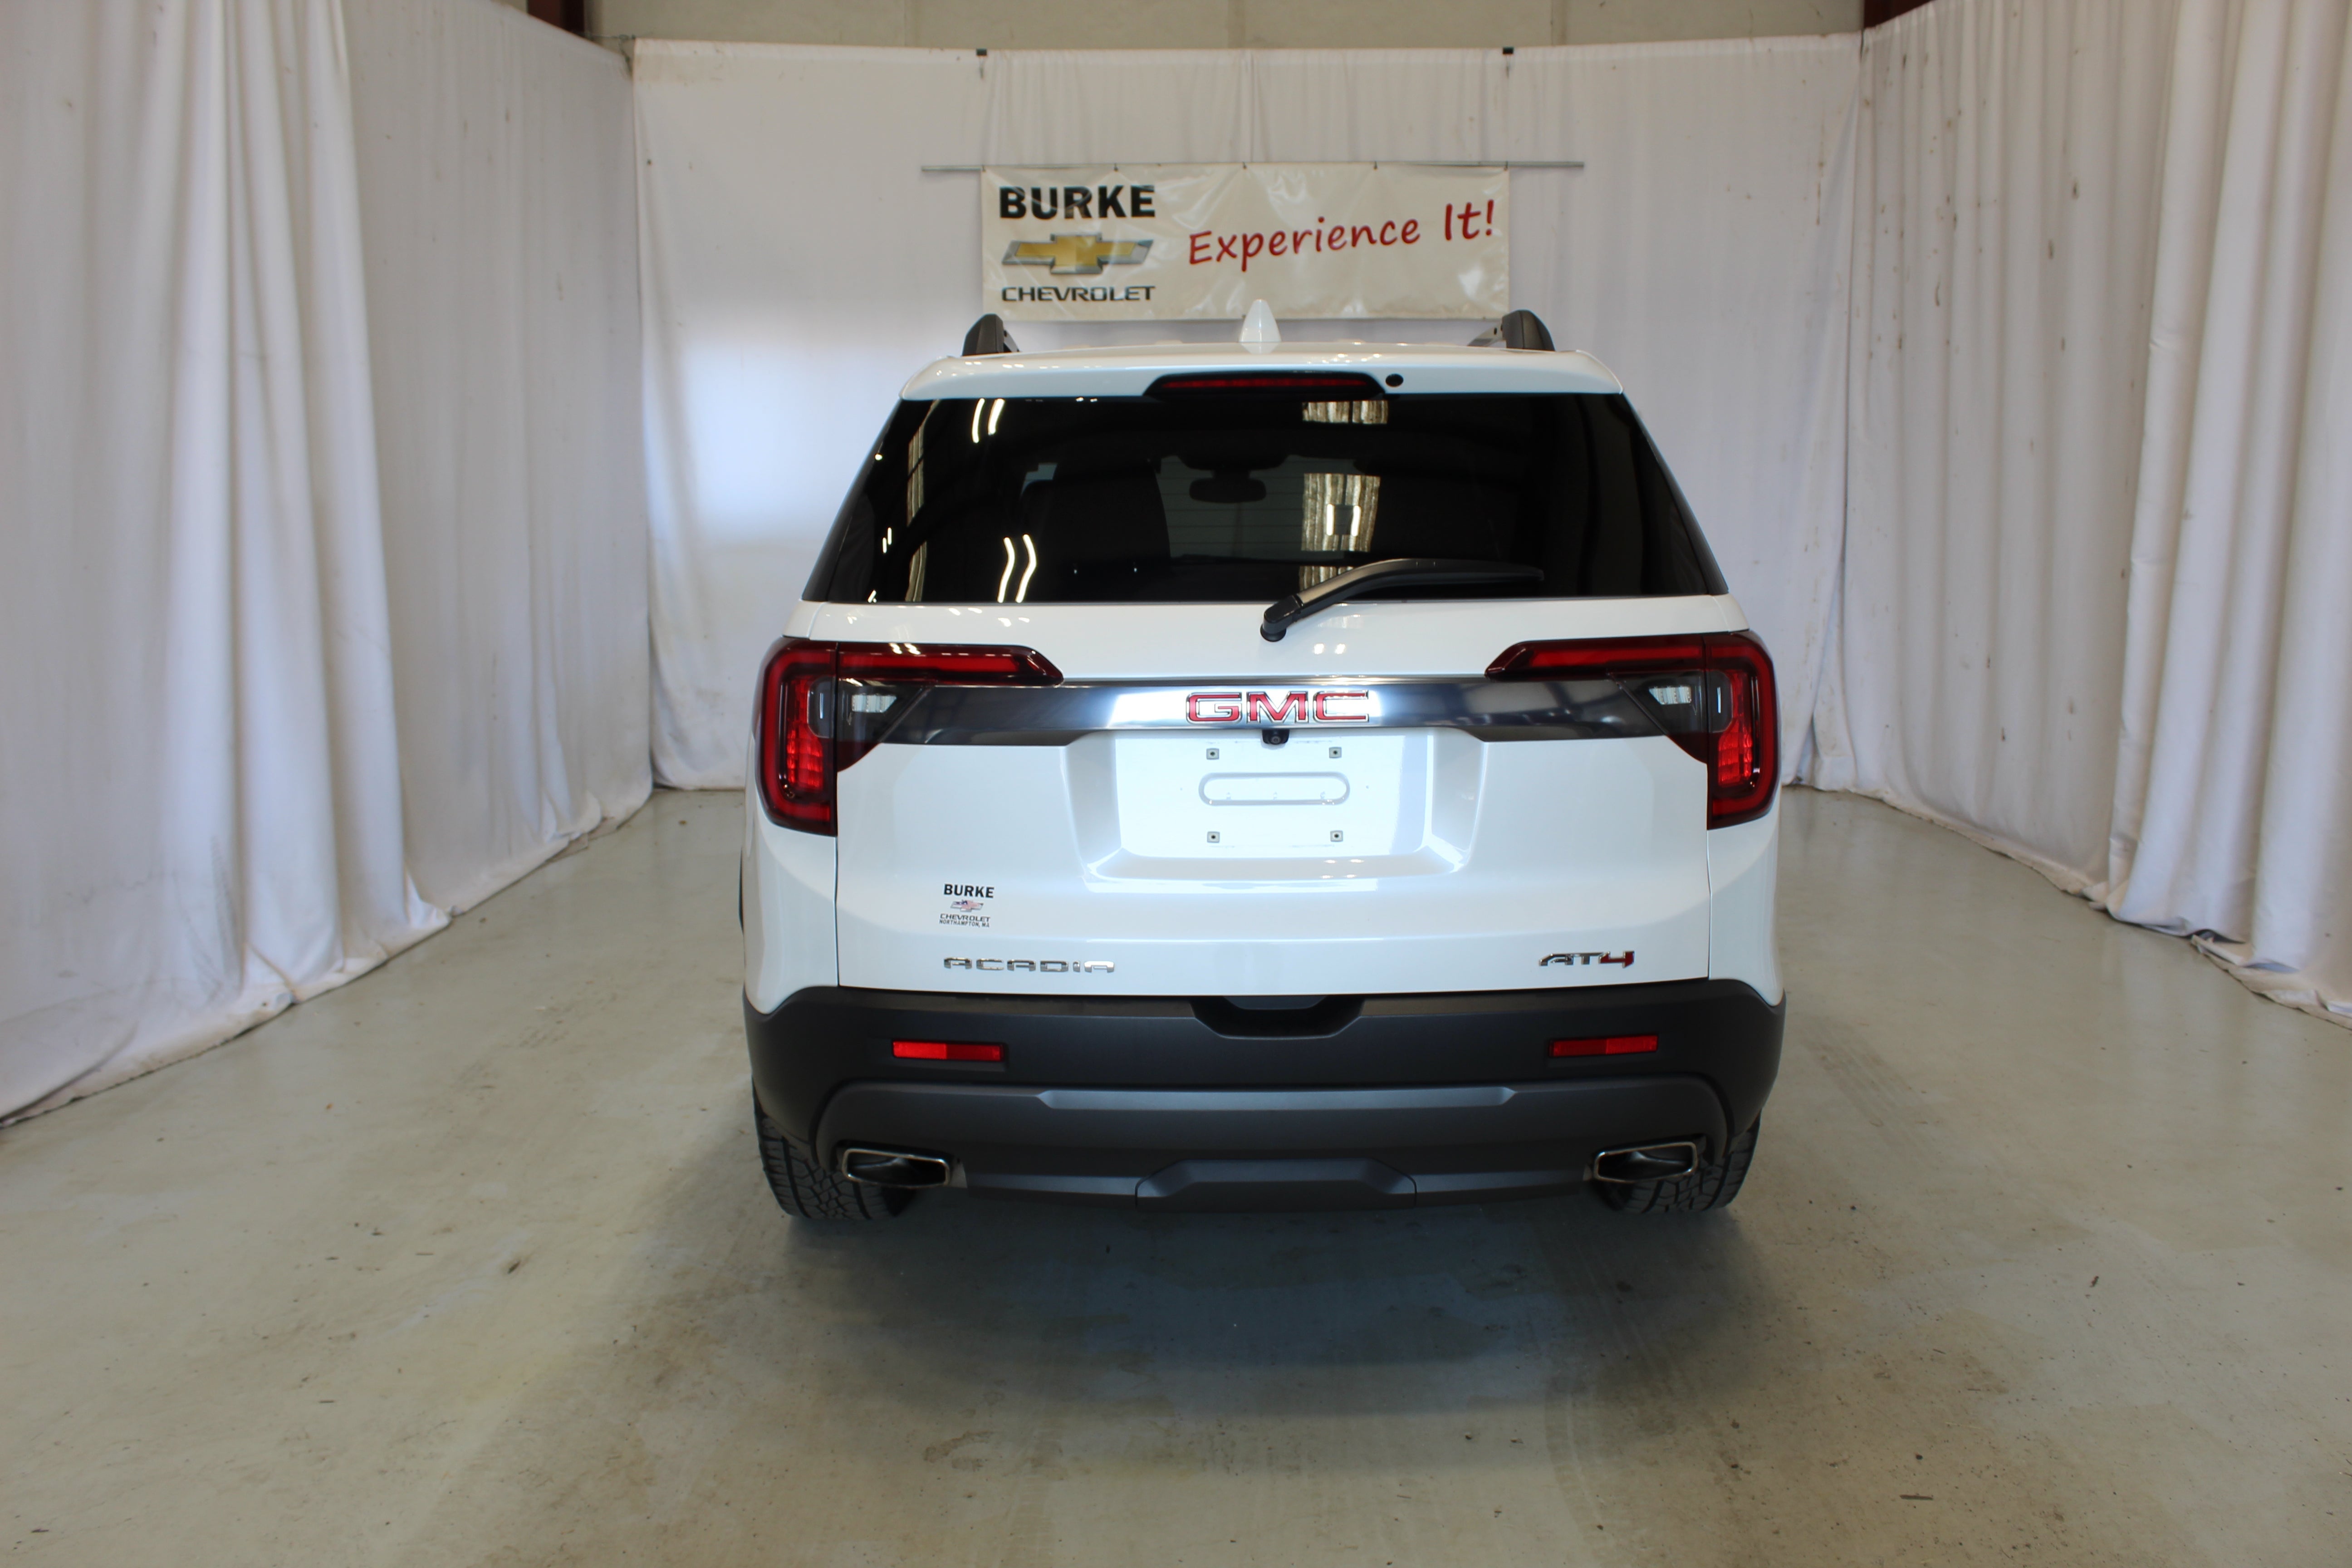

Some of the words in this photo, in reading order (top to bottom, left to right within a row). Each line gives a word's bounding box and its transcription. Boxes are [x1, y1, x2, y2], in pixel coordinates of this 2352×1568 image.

[1000, 185, 1156, 220] BURKE
[1189, 217, 1421, 272] Experience
[1444, 200, 1494, 240] It!
[1001, 285, 1156, 302] CHEVROLET
[1186, 690, 1369, 724] GMC
[944, 884, 995, 898] BURKE
[939, 919, 980, 928] NORTHAMPTON,
[940, 913, 990, 922] CHEVROLET
[944, 957, 1115, 973] ACADIA
[1539, 950, 1635, 969] AT4
